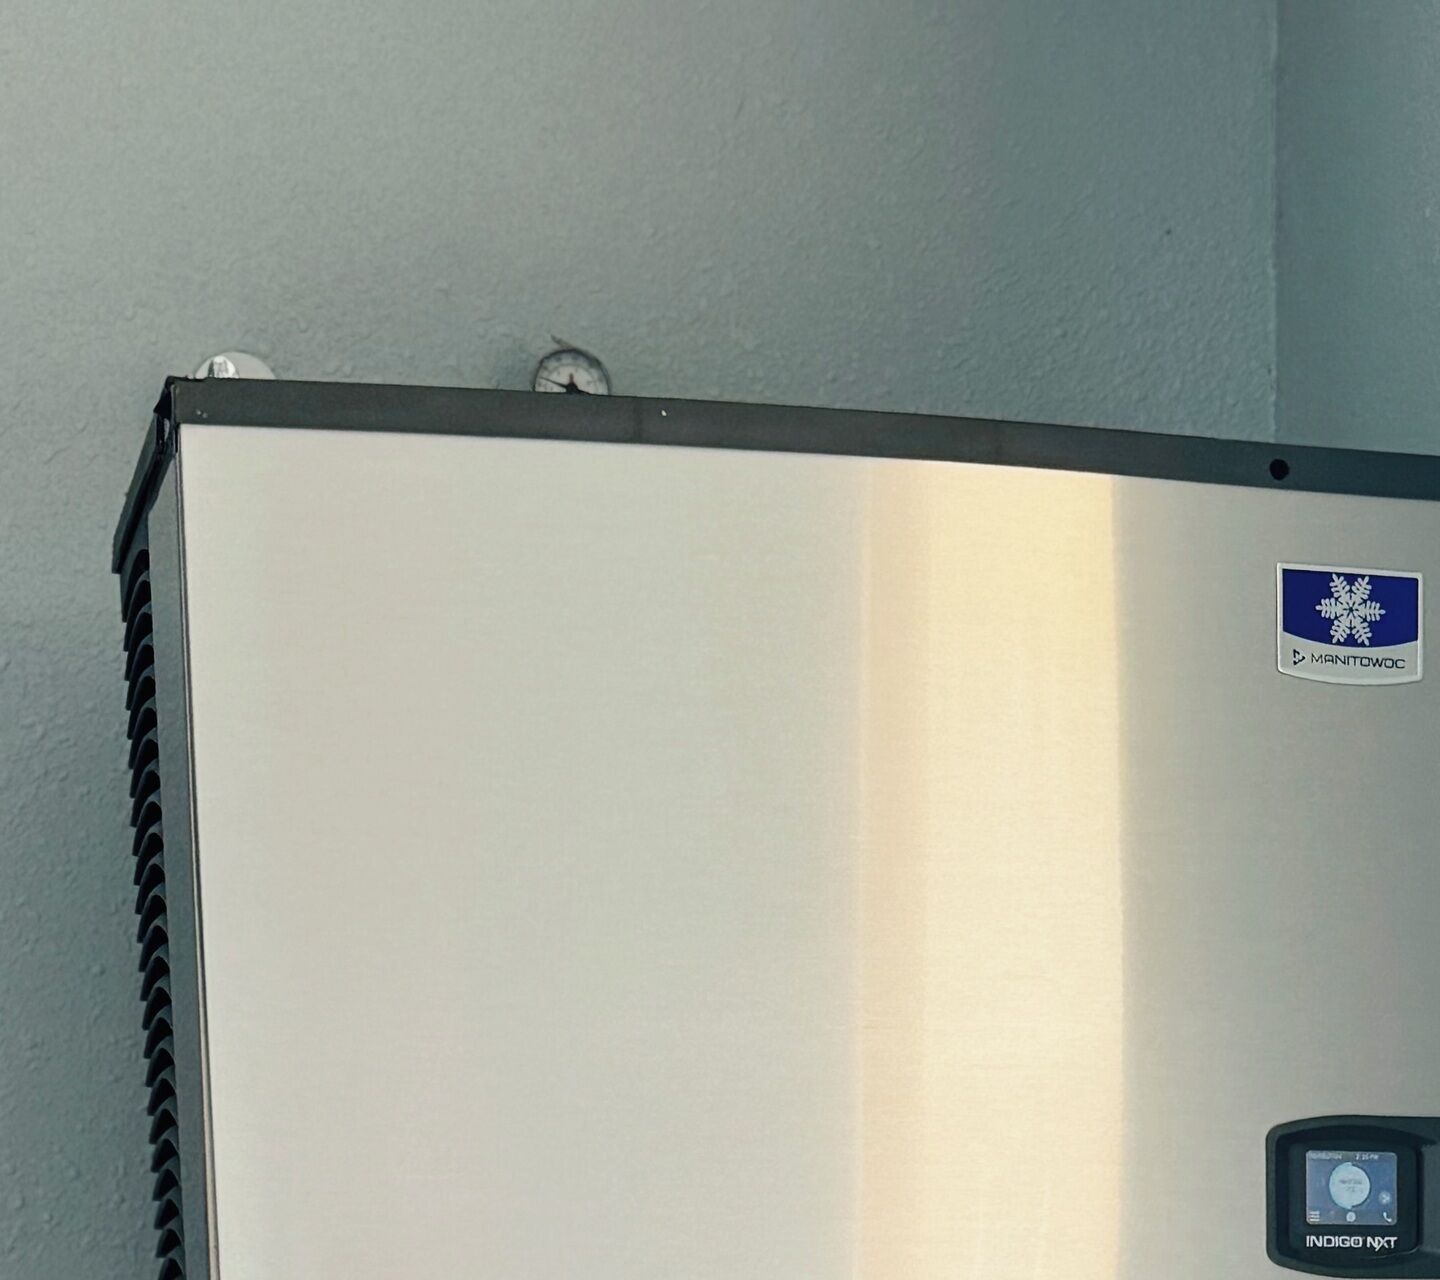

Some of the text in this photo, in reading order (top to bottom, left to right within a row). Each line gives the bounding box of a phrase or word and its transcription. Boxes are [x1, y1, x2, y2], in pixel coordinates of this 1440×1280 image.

[1311, 652, 1406, 669] MANITOWOC
[1306, 1235, 1397, 1251] INDIGO NXT
